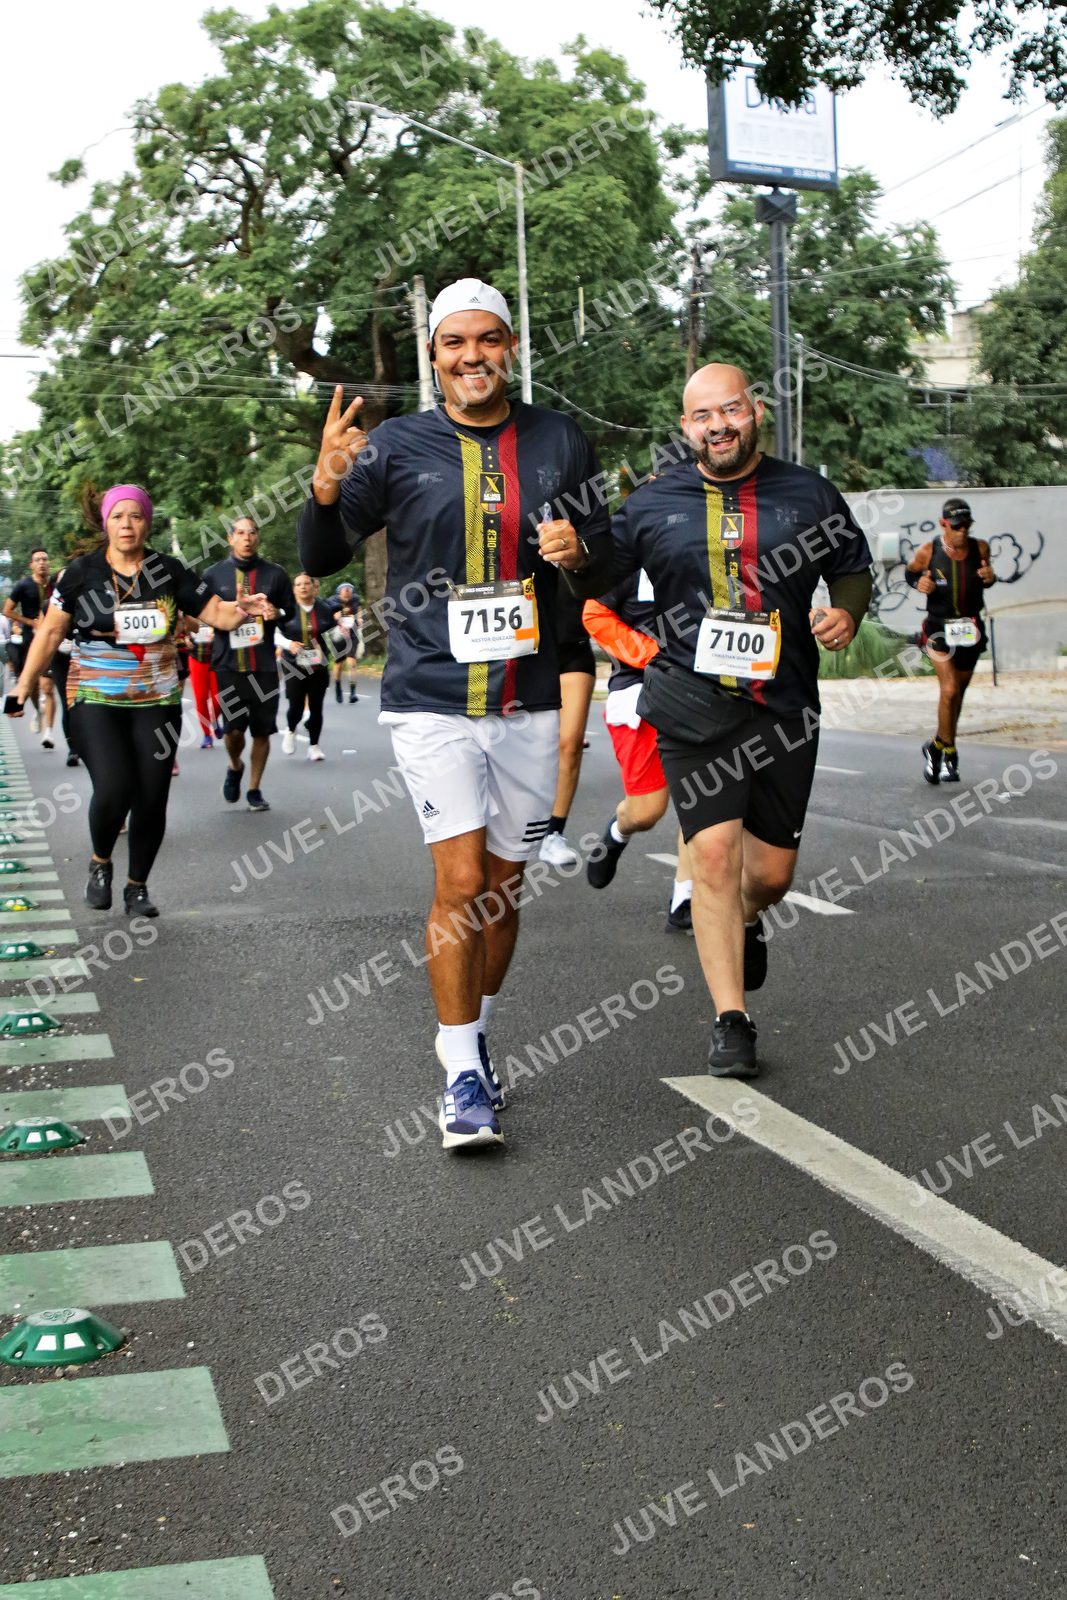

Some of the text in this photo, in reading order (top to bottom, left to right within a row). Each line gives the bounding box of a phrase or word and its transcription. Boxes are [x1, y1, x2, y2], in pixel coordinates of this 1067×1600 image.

[124, 615, 156, 629] 5001
[460, 605, 523, 634] 7156
[234, 626, 256, 637] 4163
[710, 628, 764, 654] 7100
